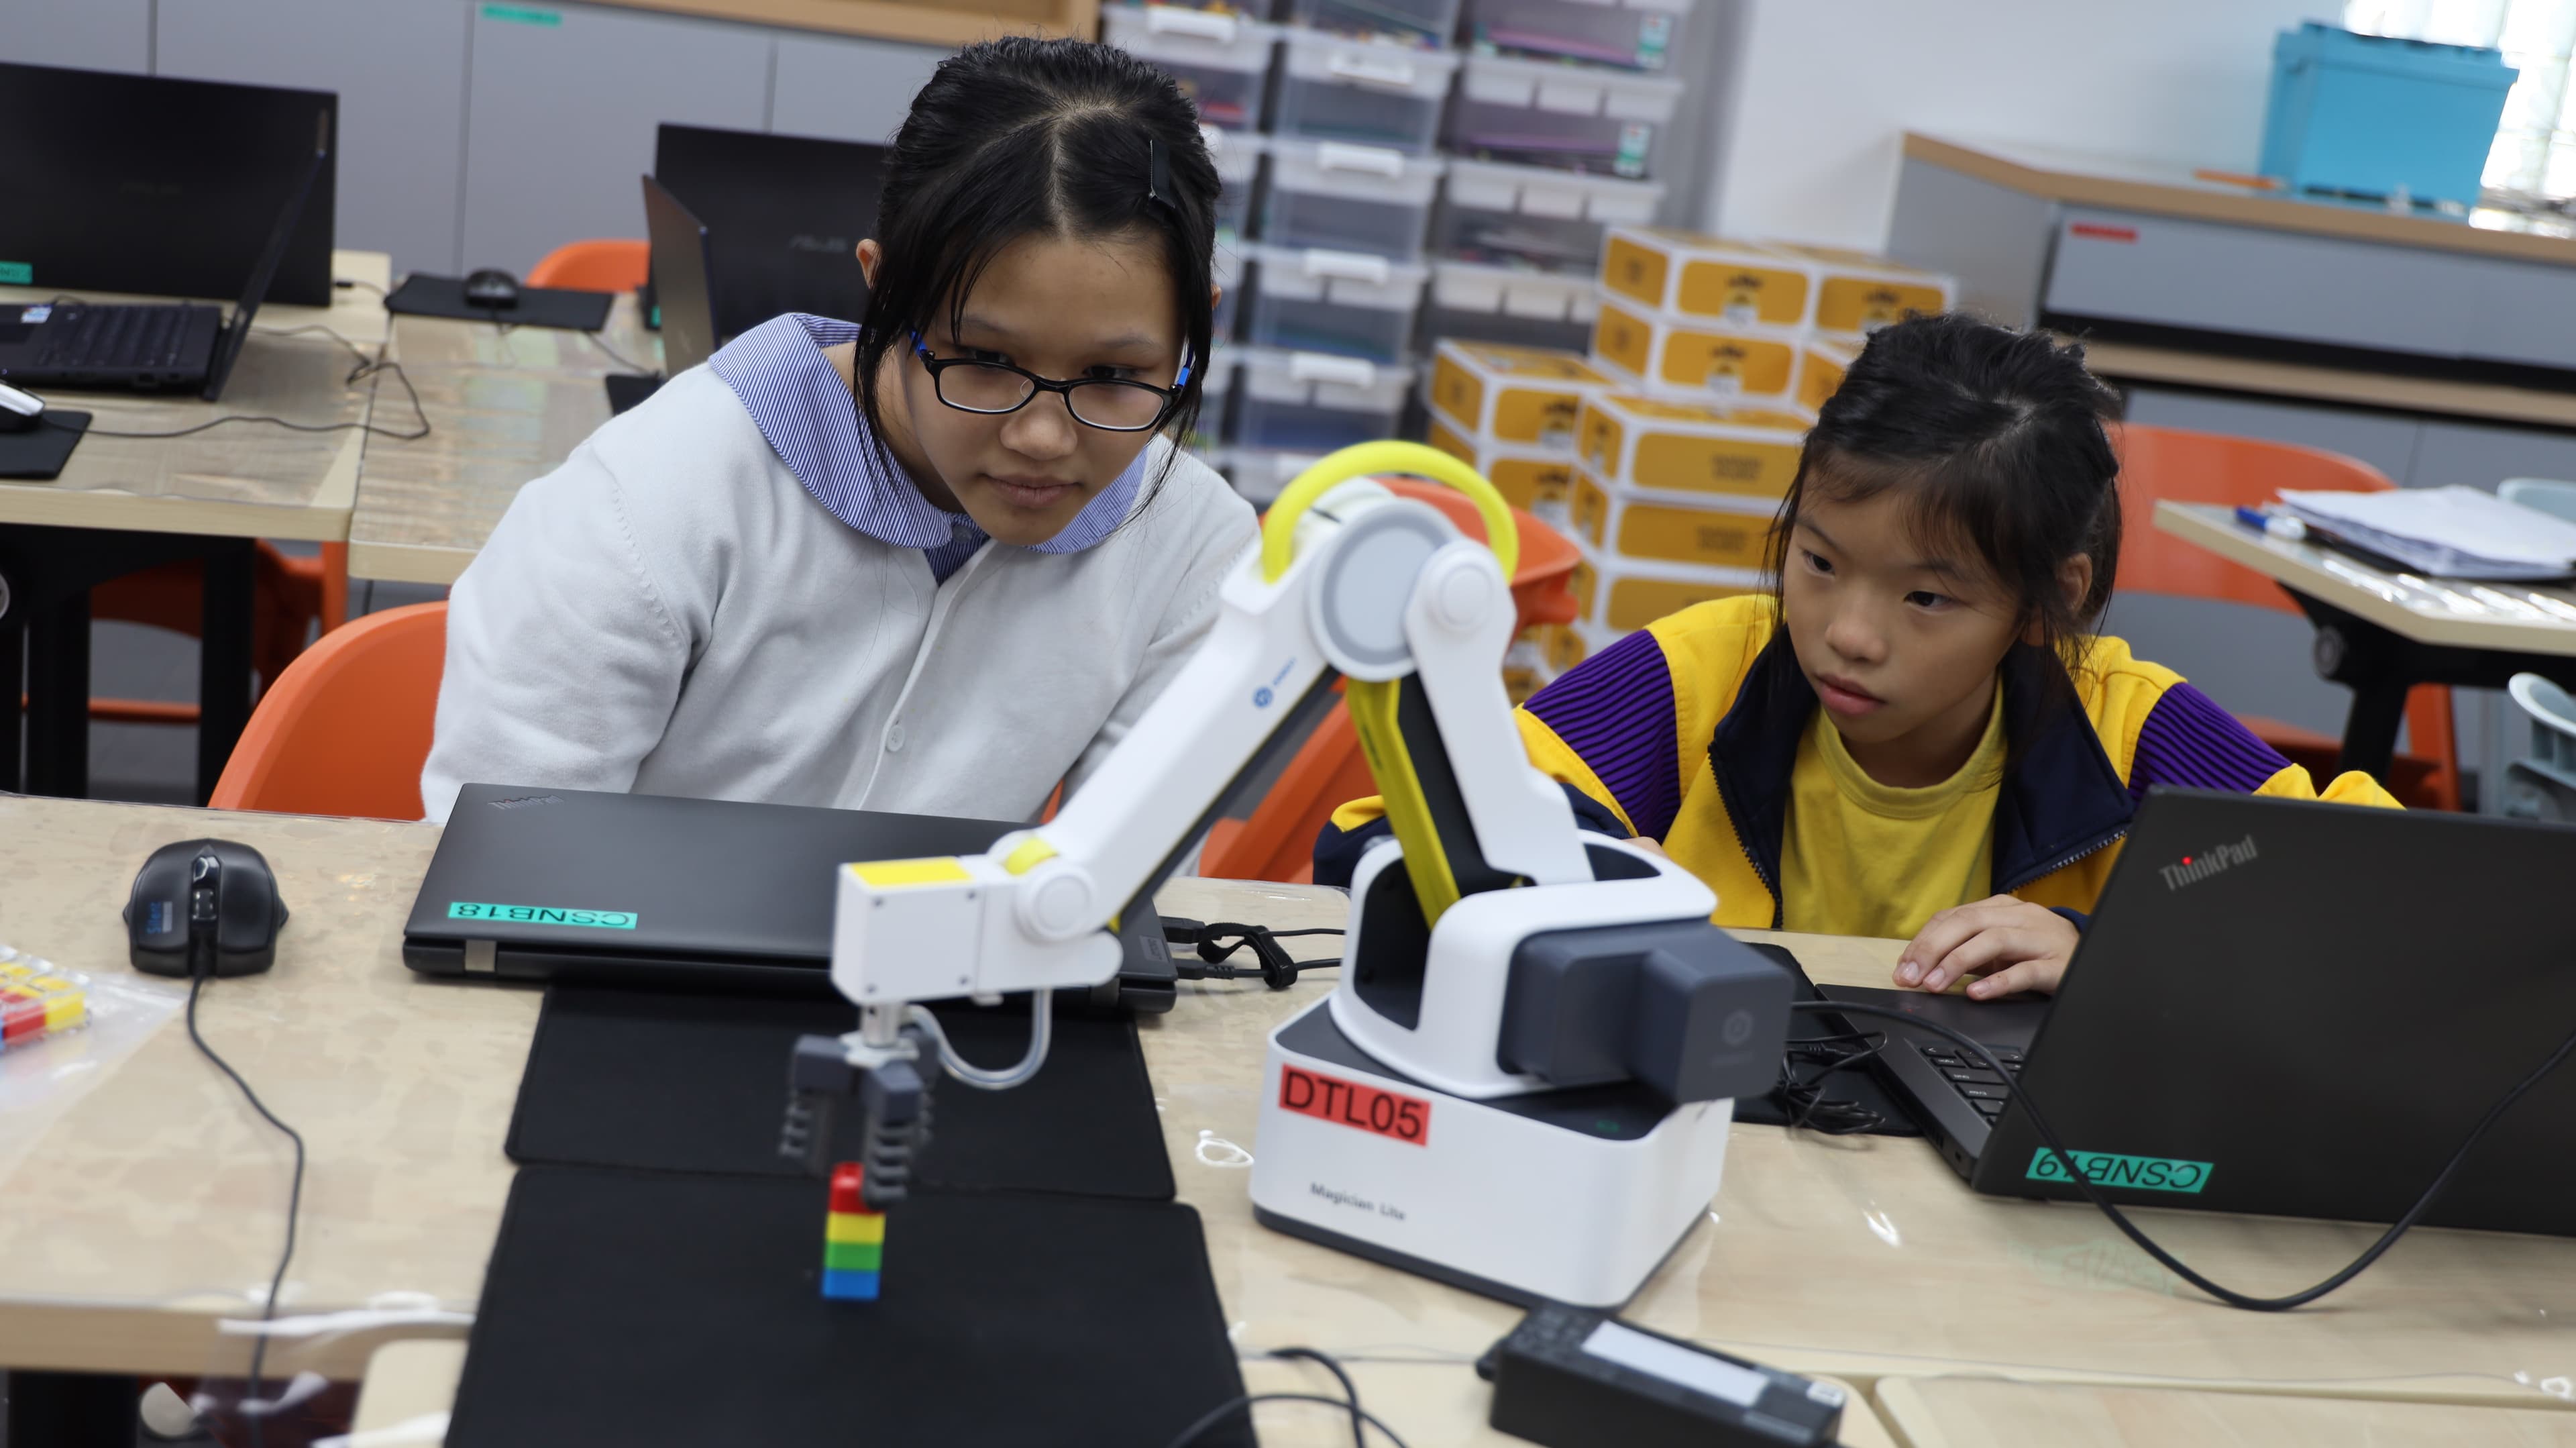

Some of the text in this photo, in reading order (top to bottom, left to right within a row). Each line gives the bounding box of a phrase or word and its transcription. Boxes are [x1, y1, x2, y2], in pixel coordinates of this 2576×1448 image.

[488, 794, 564, 810] ThinkPad
[2158, 834, 2257, 891] ThinkPad
[458, 903, 629, 927] CSNB18
[1284, 1071, 1421, 1139] DTL05
[1310, 1182, 1406, 1221] Magician Lite
